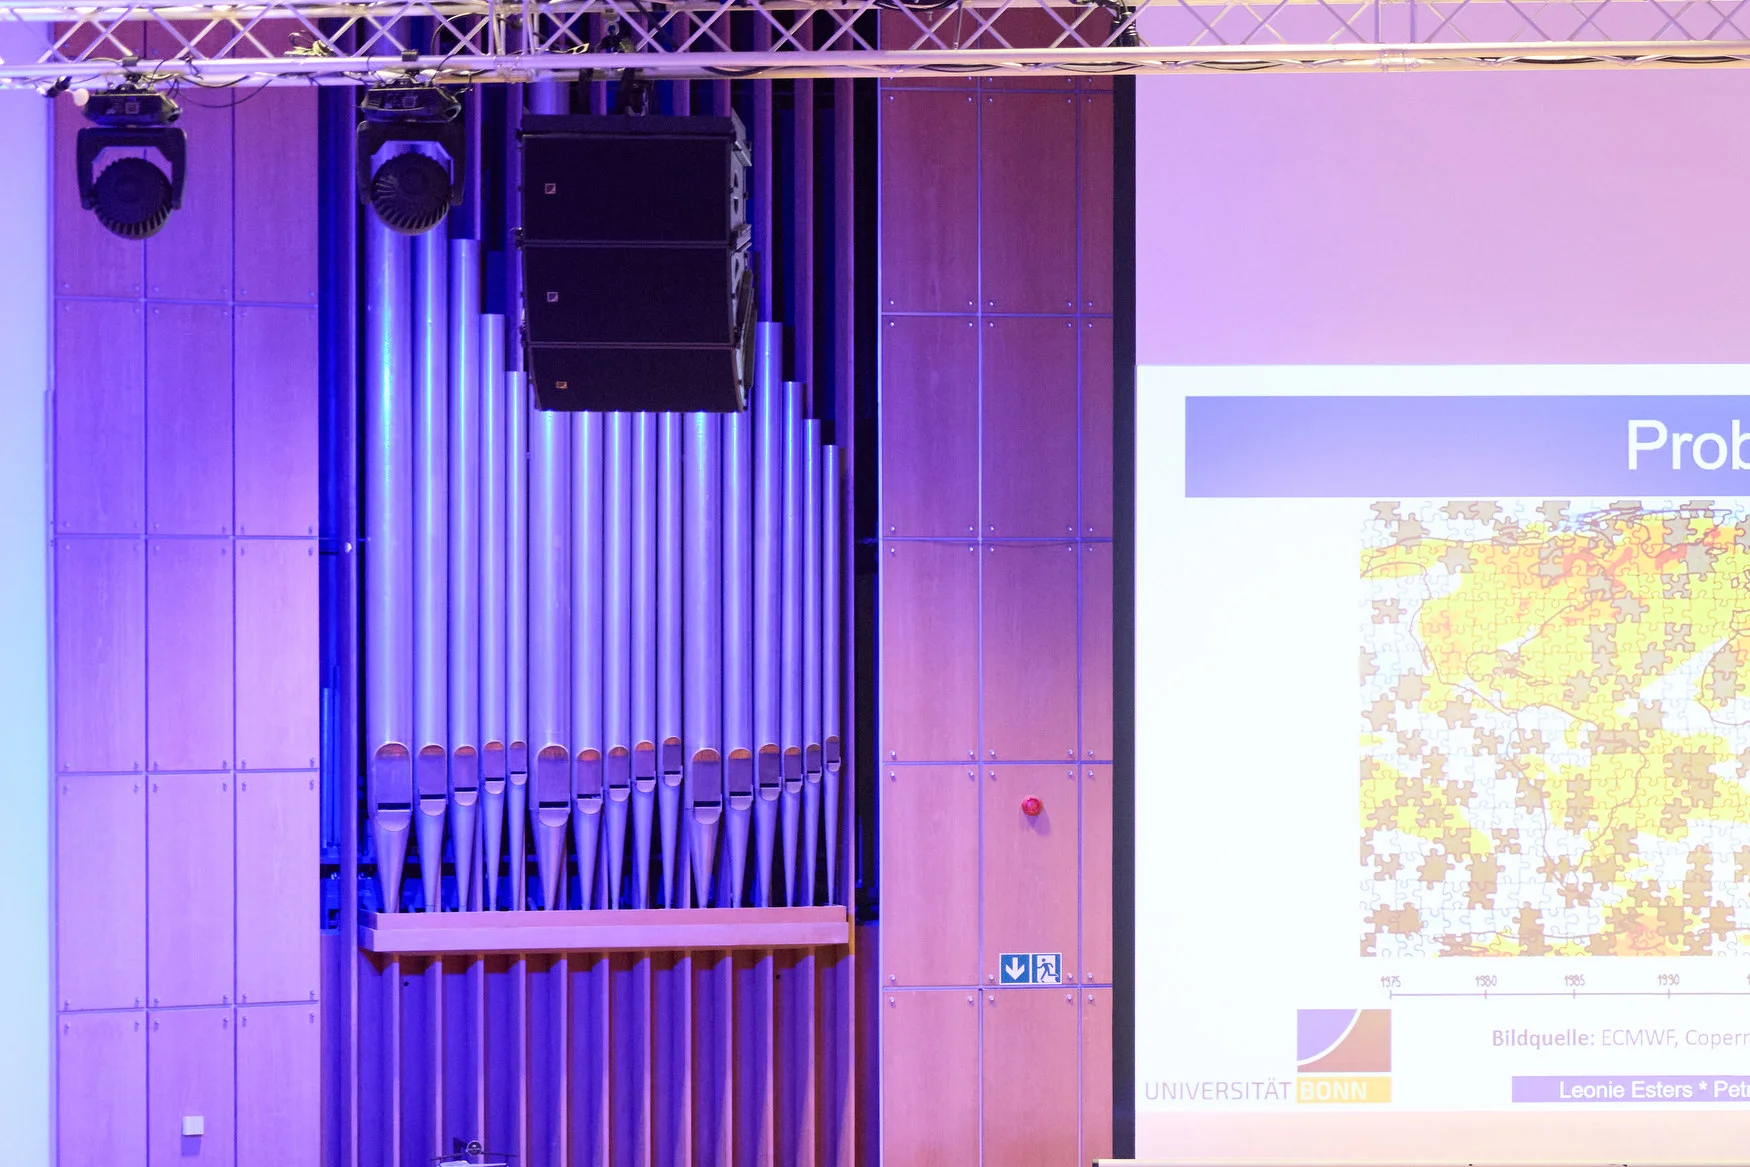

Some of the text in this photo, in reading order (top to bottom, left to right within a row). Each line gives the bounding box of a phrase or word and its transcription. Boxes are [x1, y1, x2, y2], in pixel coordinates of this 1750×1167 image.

[1380, 974, 1402, 988] 1975
[1475, 974, 1497, 987] 1980
[1564, 973, 1586, 987] 1985
[1657, 973, 1680, 987] 1990
[1491, 1029, 1596, 1051] Bildquelle:
[1601, 1029, 1678, 1049] ECMWF,
[1144, 1077, 1368, 1101] UNIVERSITÄT BONN
[1559, 1081, 1625, 1099] Leonie
[1631, 1081, 1694, 1099] Esters
